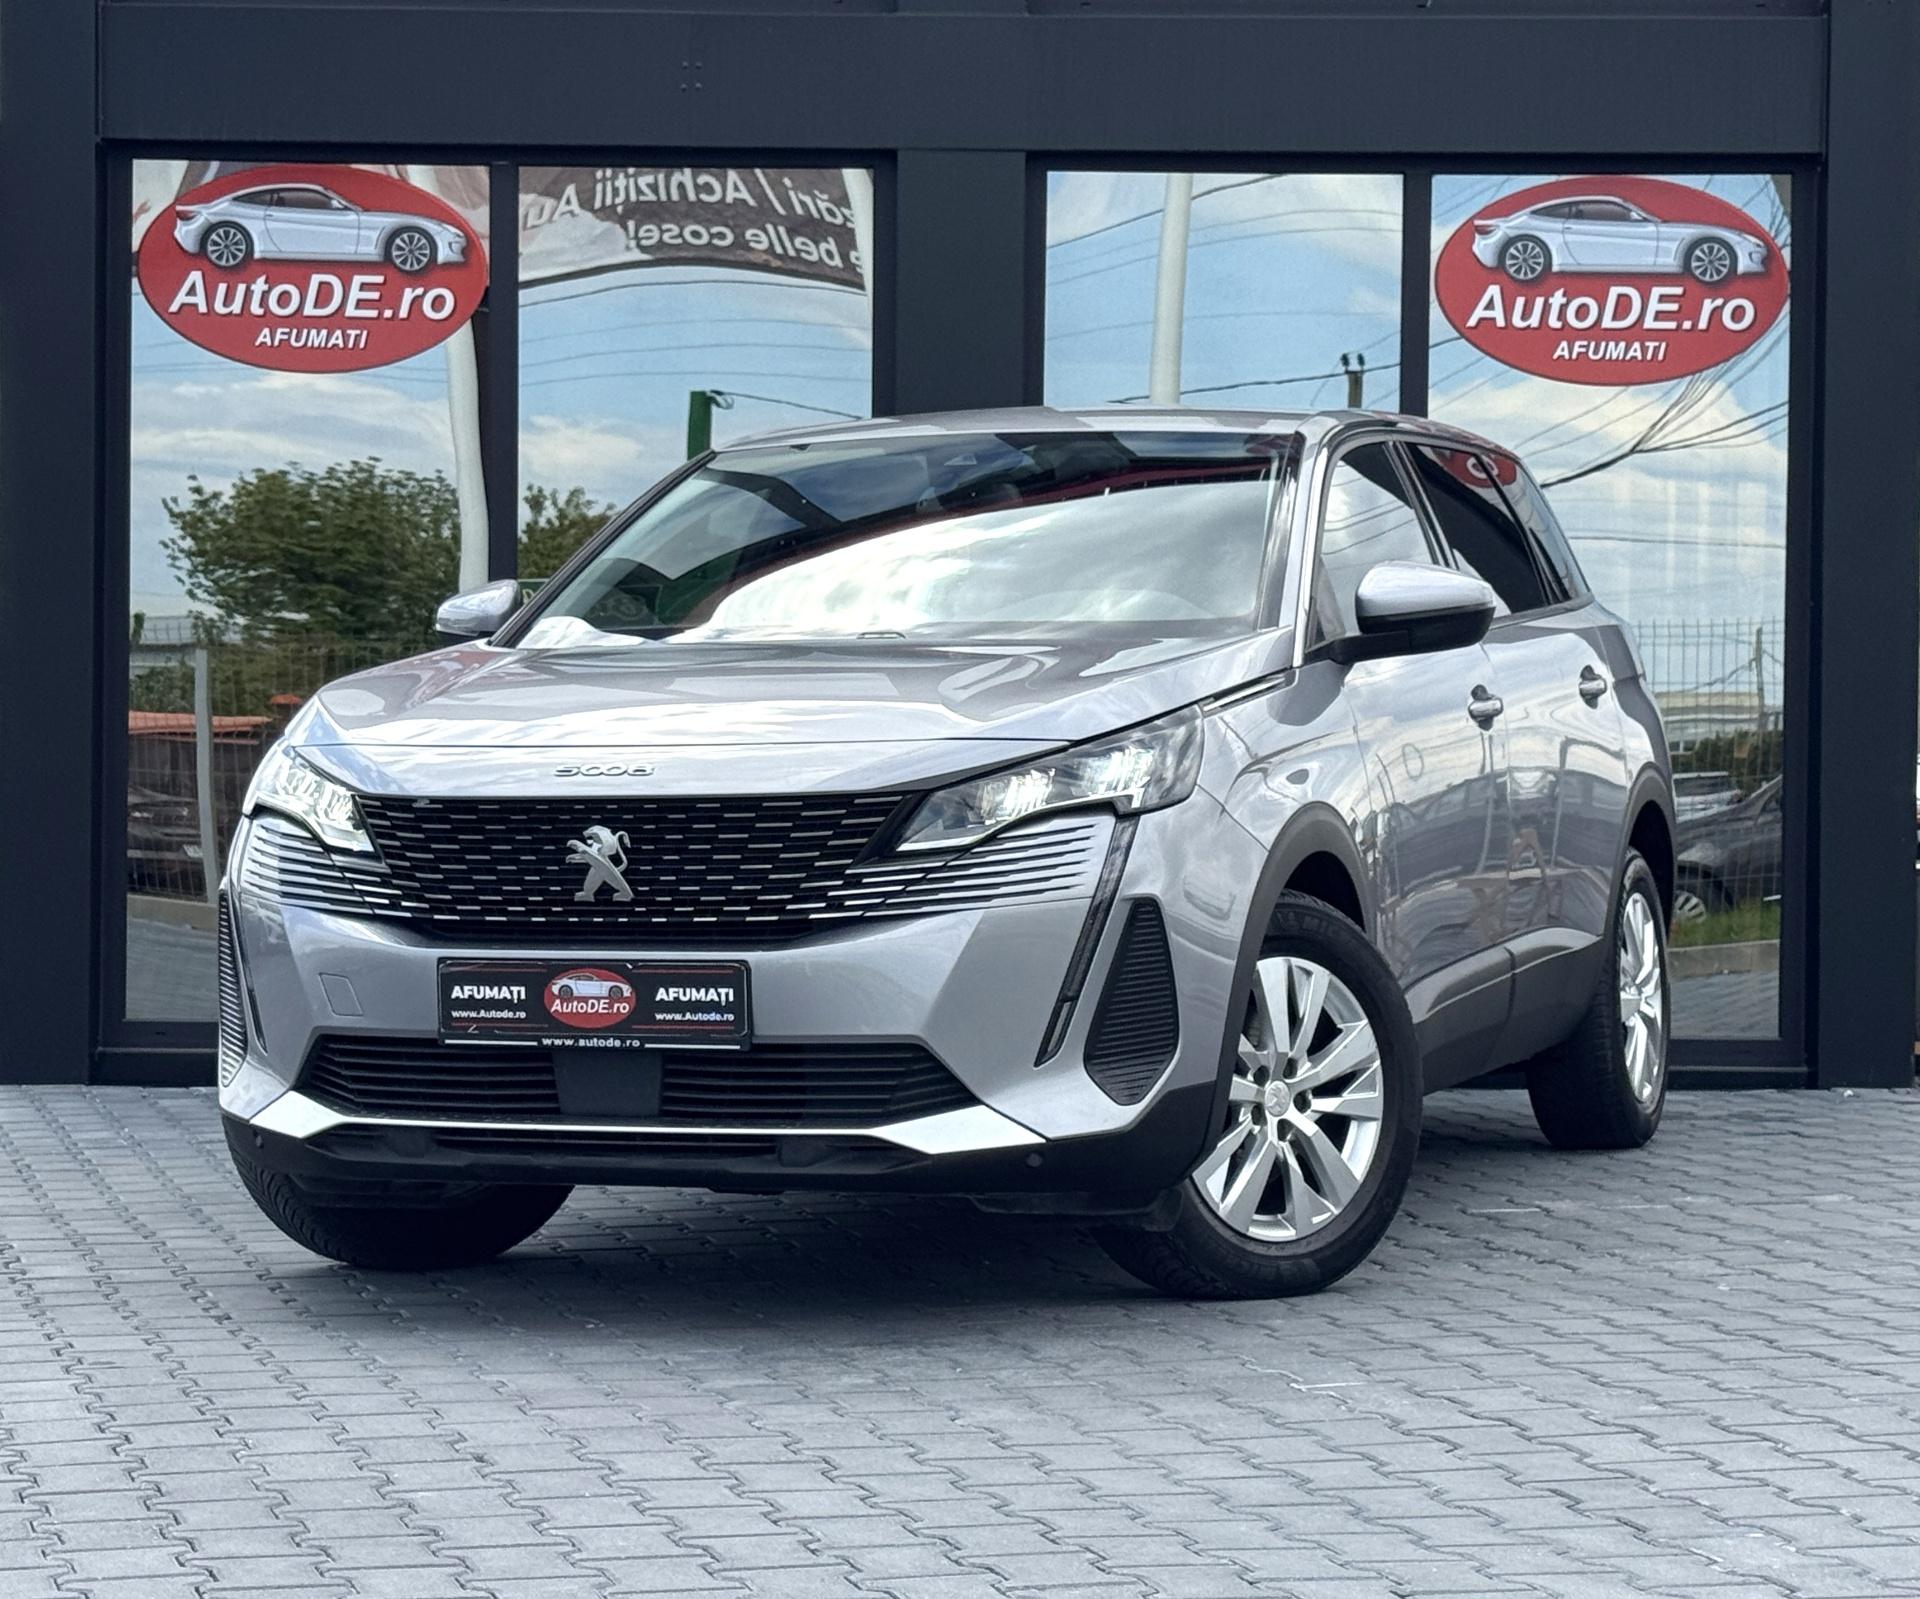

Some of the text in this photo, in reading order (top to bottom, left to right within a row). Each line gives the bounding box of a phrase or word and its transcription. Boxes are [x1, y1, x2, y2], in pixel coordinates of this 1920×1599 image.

[168, 270, 456, 321] AutoDE.ro
[1465, 284, 1756, 331] AutoDE.ro
[255, 327, 369, 350] AFUMATI
[1553, 341, 1668, 362] AFUMATI
[554, 763, 656, 778] 5008
[451, 1008, 527, 1019] www.Autode.ro
[550, 998, 630, 1014] AutoDE.ro
[655, 1011, 735, 1022] www.Autode.ro
[541, 1037, 641, 1048] www.autode.ro
